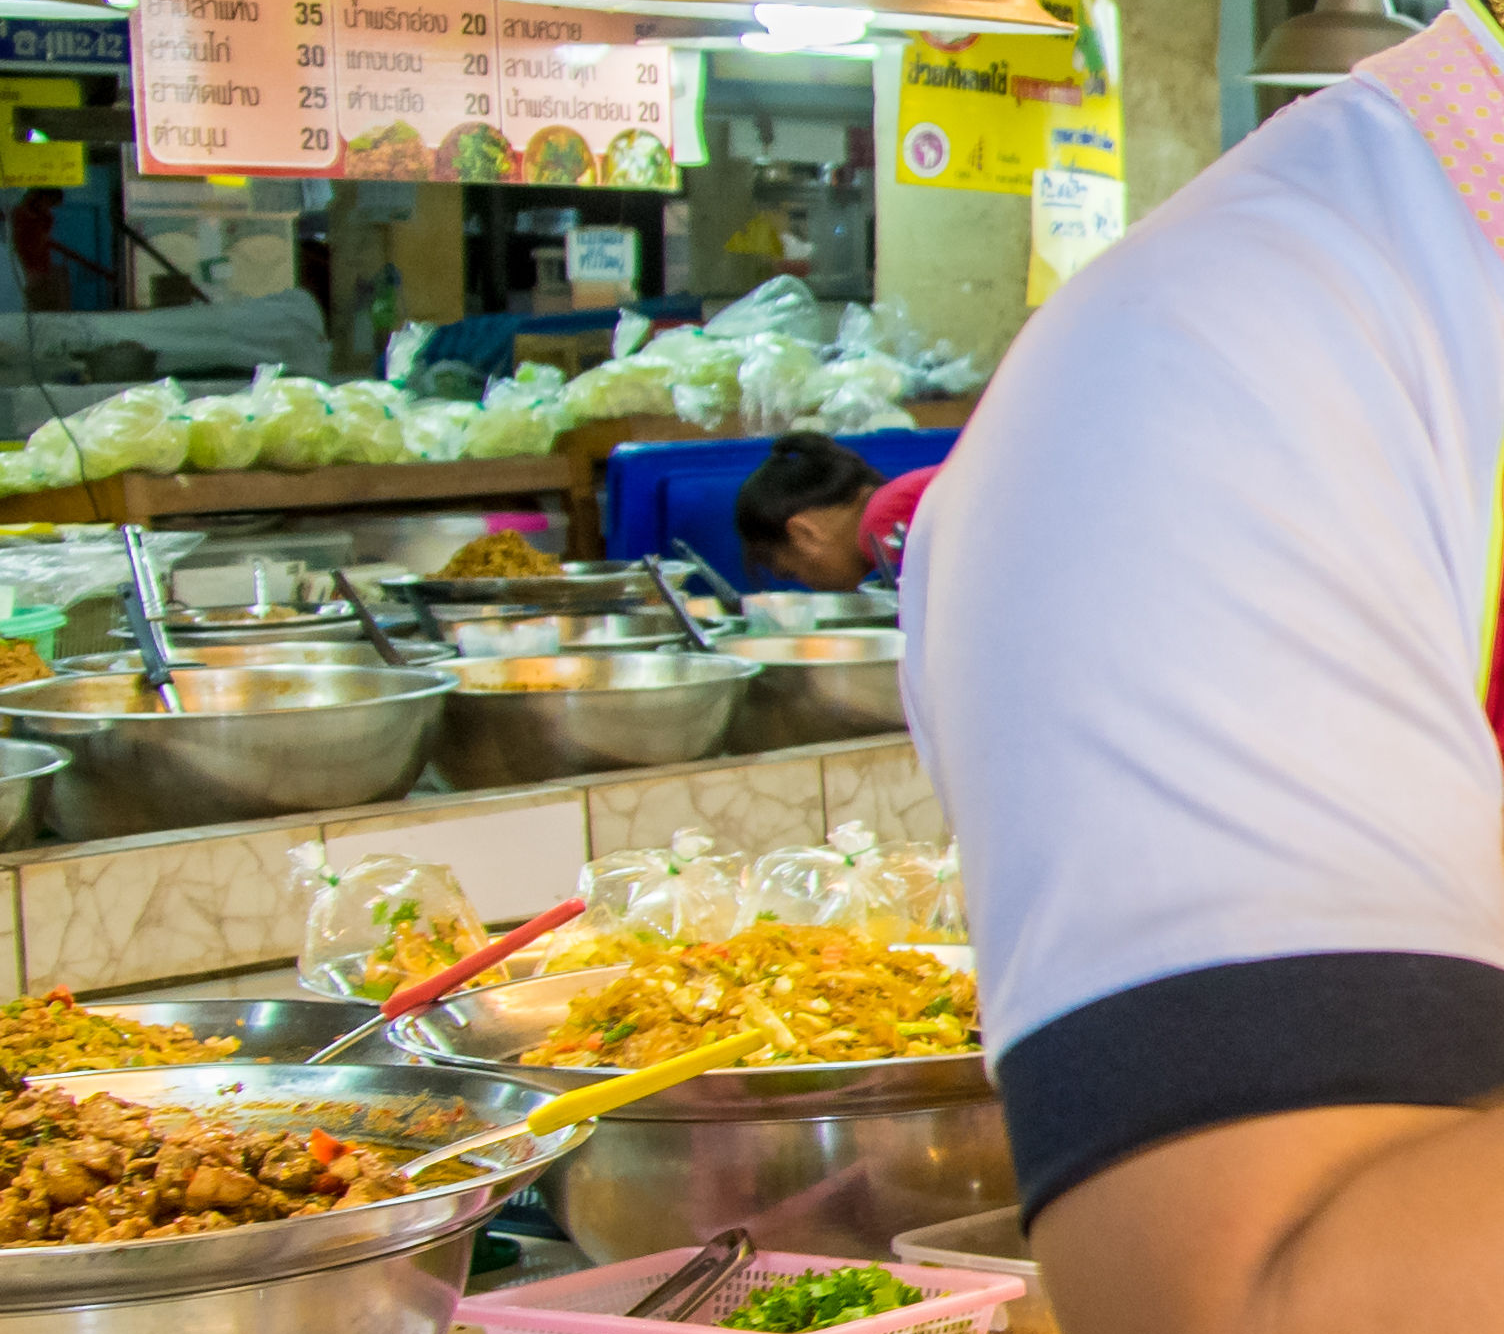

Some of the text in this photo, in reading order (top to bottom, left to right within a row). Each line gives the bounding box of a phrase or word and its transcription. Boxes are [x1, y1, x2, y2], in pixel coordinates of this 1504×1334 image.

[294, 0, 324, 26] 35
[460, 12, 487, 37] 20
[296, 43, 325, 68] 30
[463, 53, 489, 78] 20
[636, 62, 659, 86] 20
[298, 84, 328, 110] 25
[465, 93, 490, 117] 20
[637, 99, 660, 124] 20
[301, 126, 329, 151] 20
